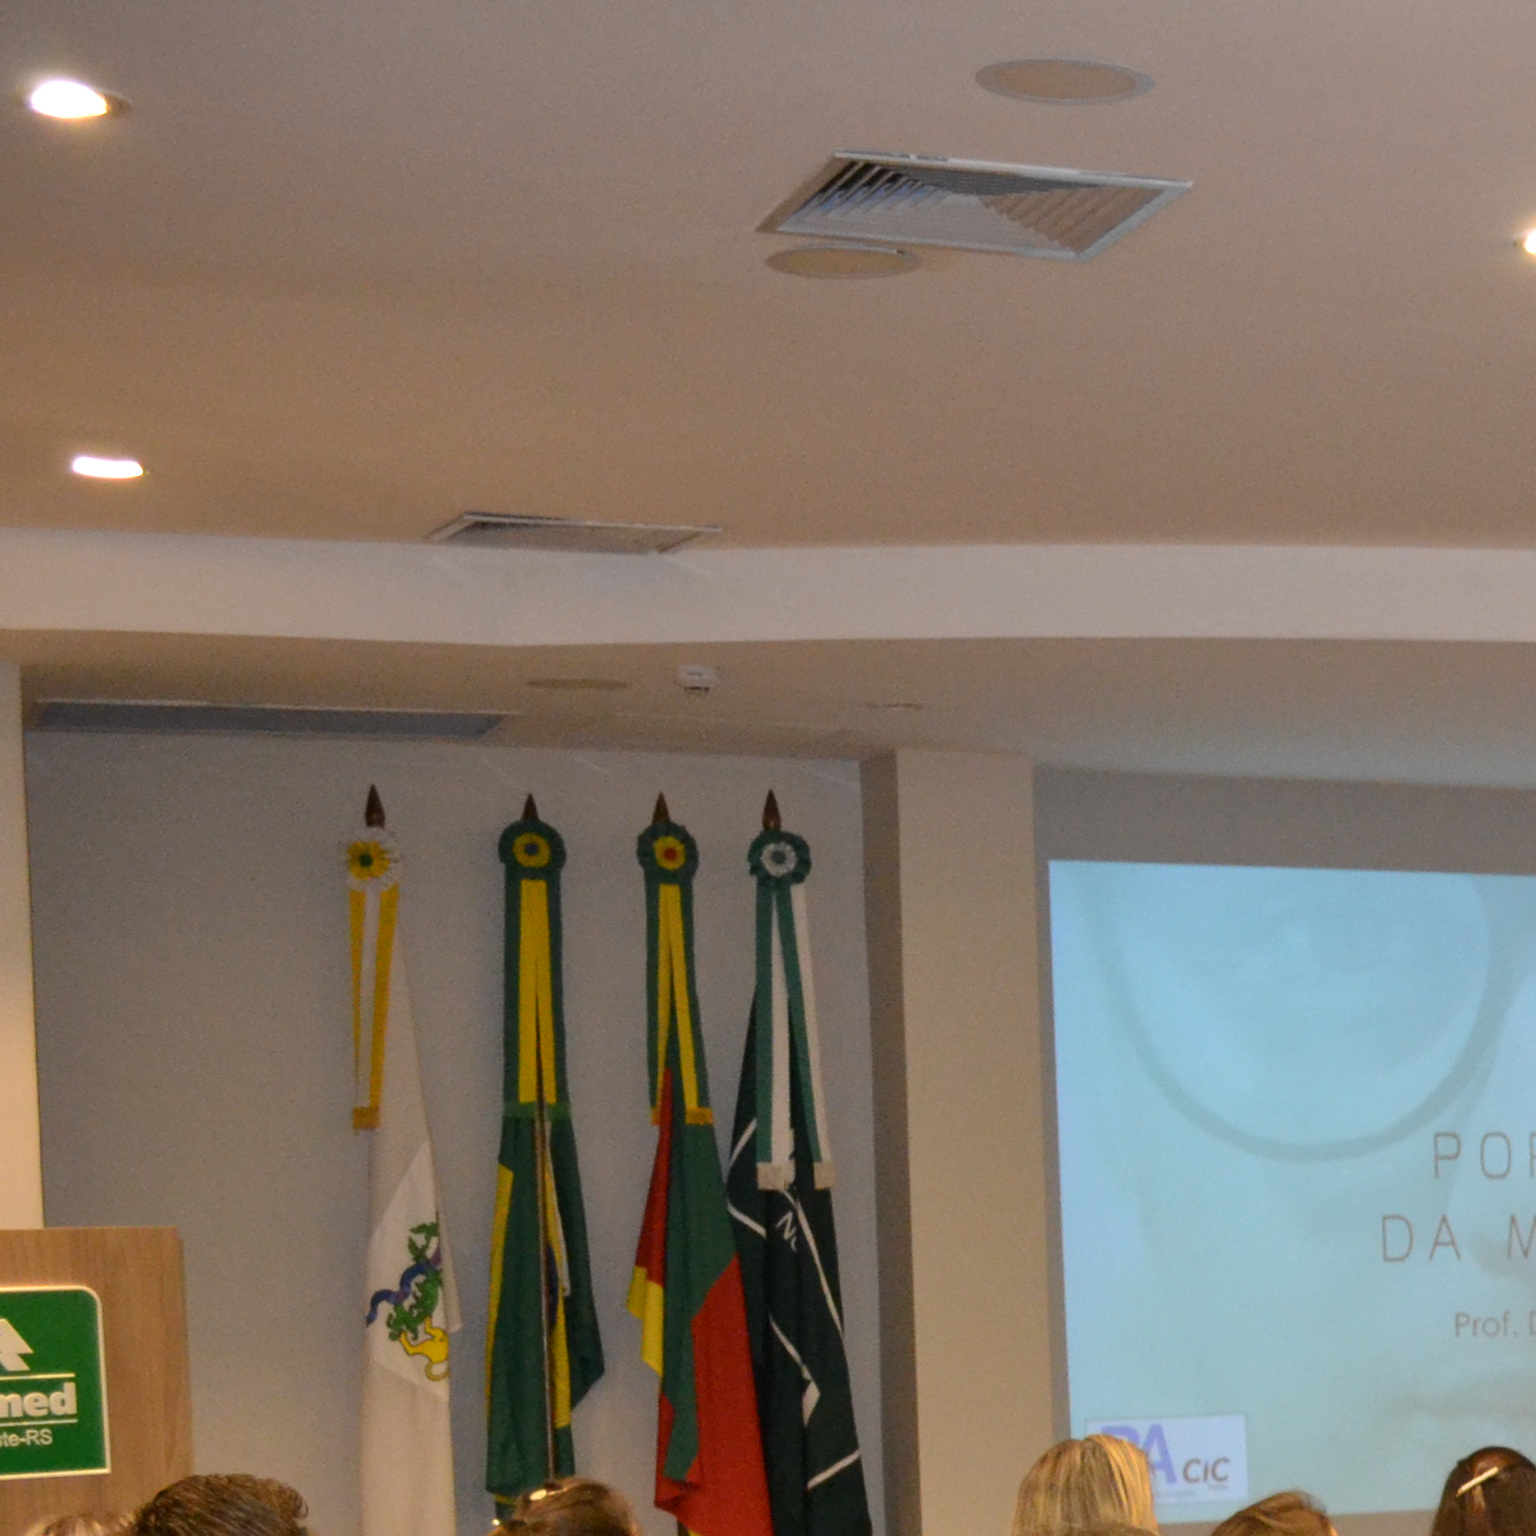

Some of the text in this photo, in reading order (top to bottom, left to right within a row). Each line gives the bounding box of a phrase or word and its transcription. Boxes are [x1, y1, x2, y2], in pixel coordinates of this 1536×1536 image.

[1381, 1213, 1462, 1263] DA
[1455, 1310, 1519, 1337] Prof.
[1183, 1457, 1230, 1484] CIC
